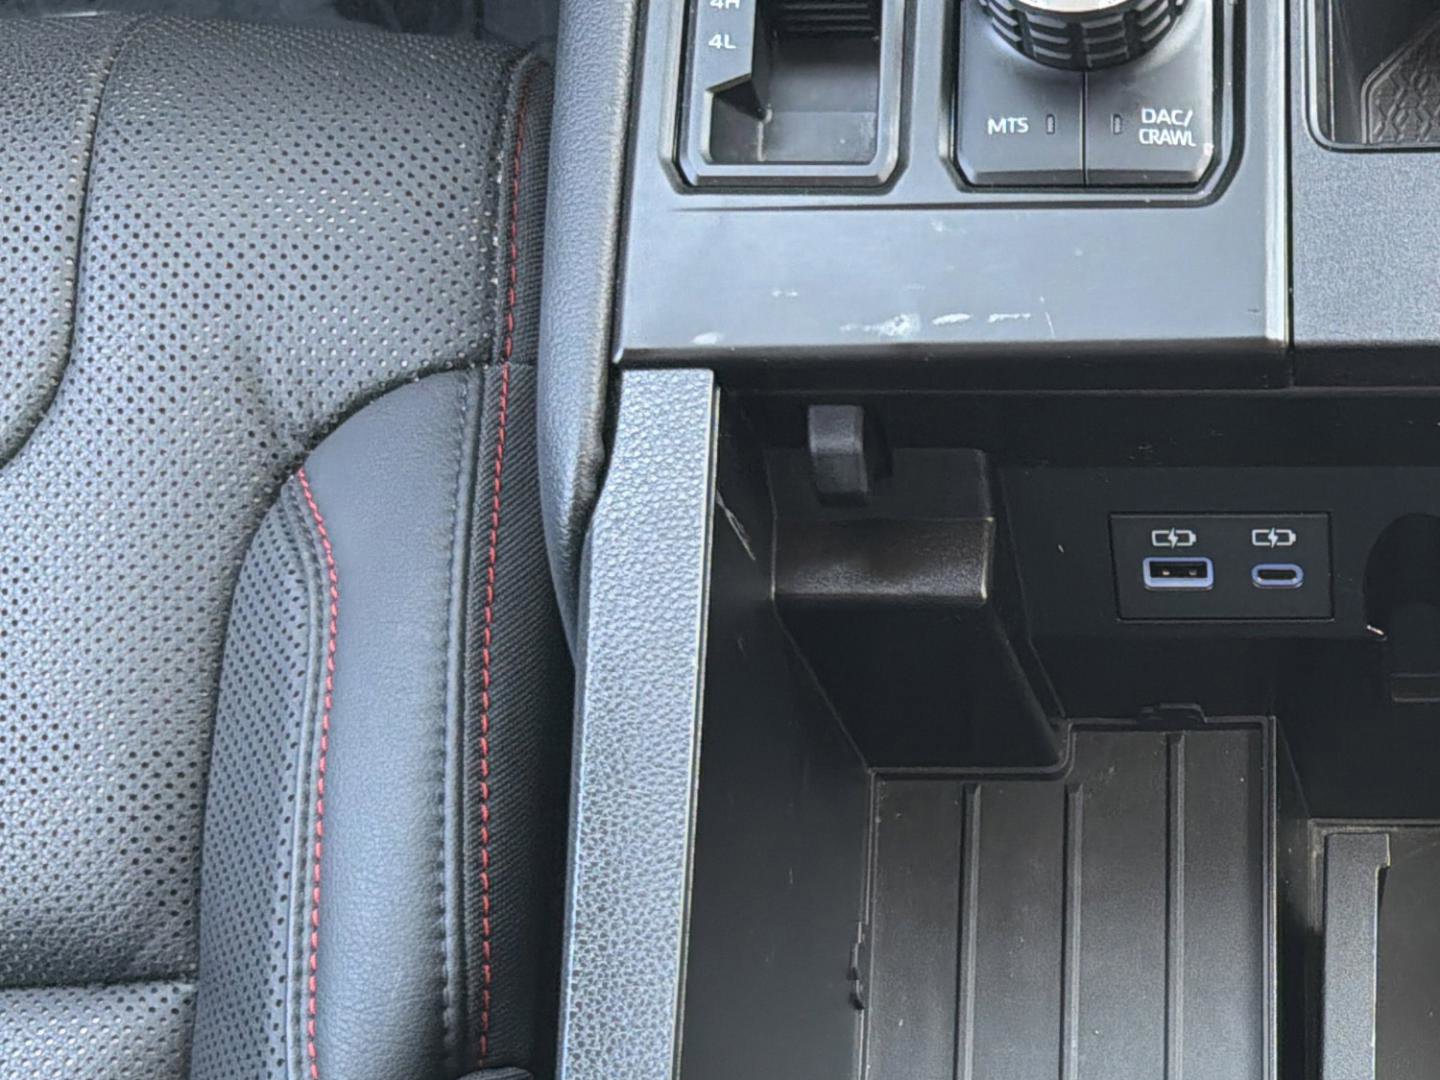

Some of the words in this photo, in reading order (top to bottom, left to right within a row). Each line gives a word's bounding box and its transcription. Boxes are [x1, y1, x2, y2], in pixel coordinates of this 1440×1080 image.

[708, 33, 737, 49] 4L
[987, 117, 1029, 135] MTS
[1141, 107, 1193, 127] DAC/
[1139, 128, 1196, 147] CRAWL
